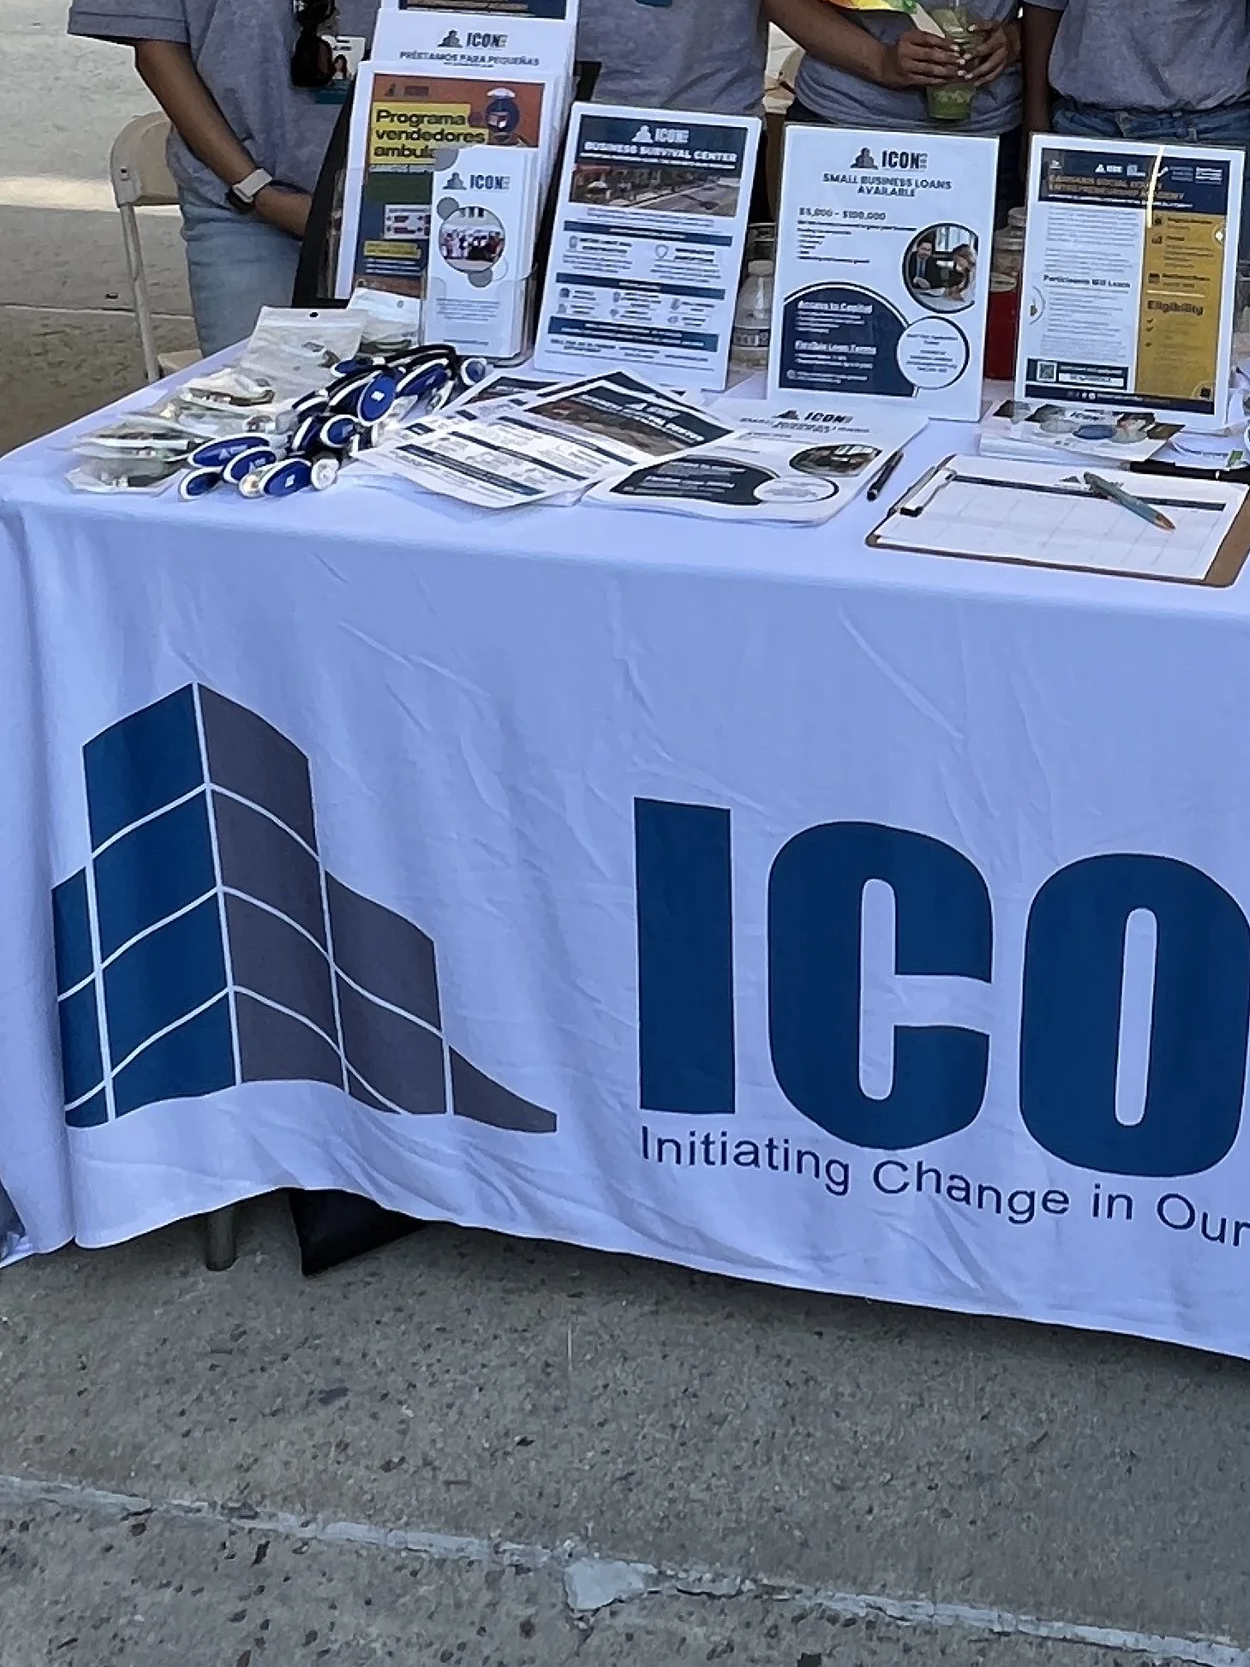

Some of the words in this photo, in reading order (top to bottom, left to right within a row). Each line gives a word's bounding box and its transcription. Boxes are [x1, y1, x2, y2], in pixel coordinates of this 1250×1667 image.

[376, 109, 466, 128] Programa
[375, 127, 486, 144] vendedores
[584, 141, 638, 154] BUSINESS
[640, 145, 691, 159] SURVIVAL
[694, 150, 738, 163] CENTER
[882, 149, 920, 169] ICON
[823, 173, 858, 185] SMALL
[860, 175, 913, 188] BUSINESS
[914, 178, 952, 190] LOANS
[857, 185, 916, 197] AVAILABLE
[1147, 299, 1204, 317] Eligibility
[642, 1126, 849, 1196] Initiating
[874, 1160, 1069, 1224] Change
[1093, 1193, 1132, 1221] in
[1157, 1194, 1250, 1246] Our
